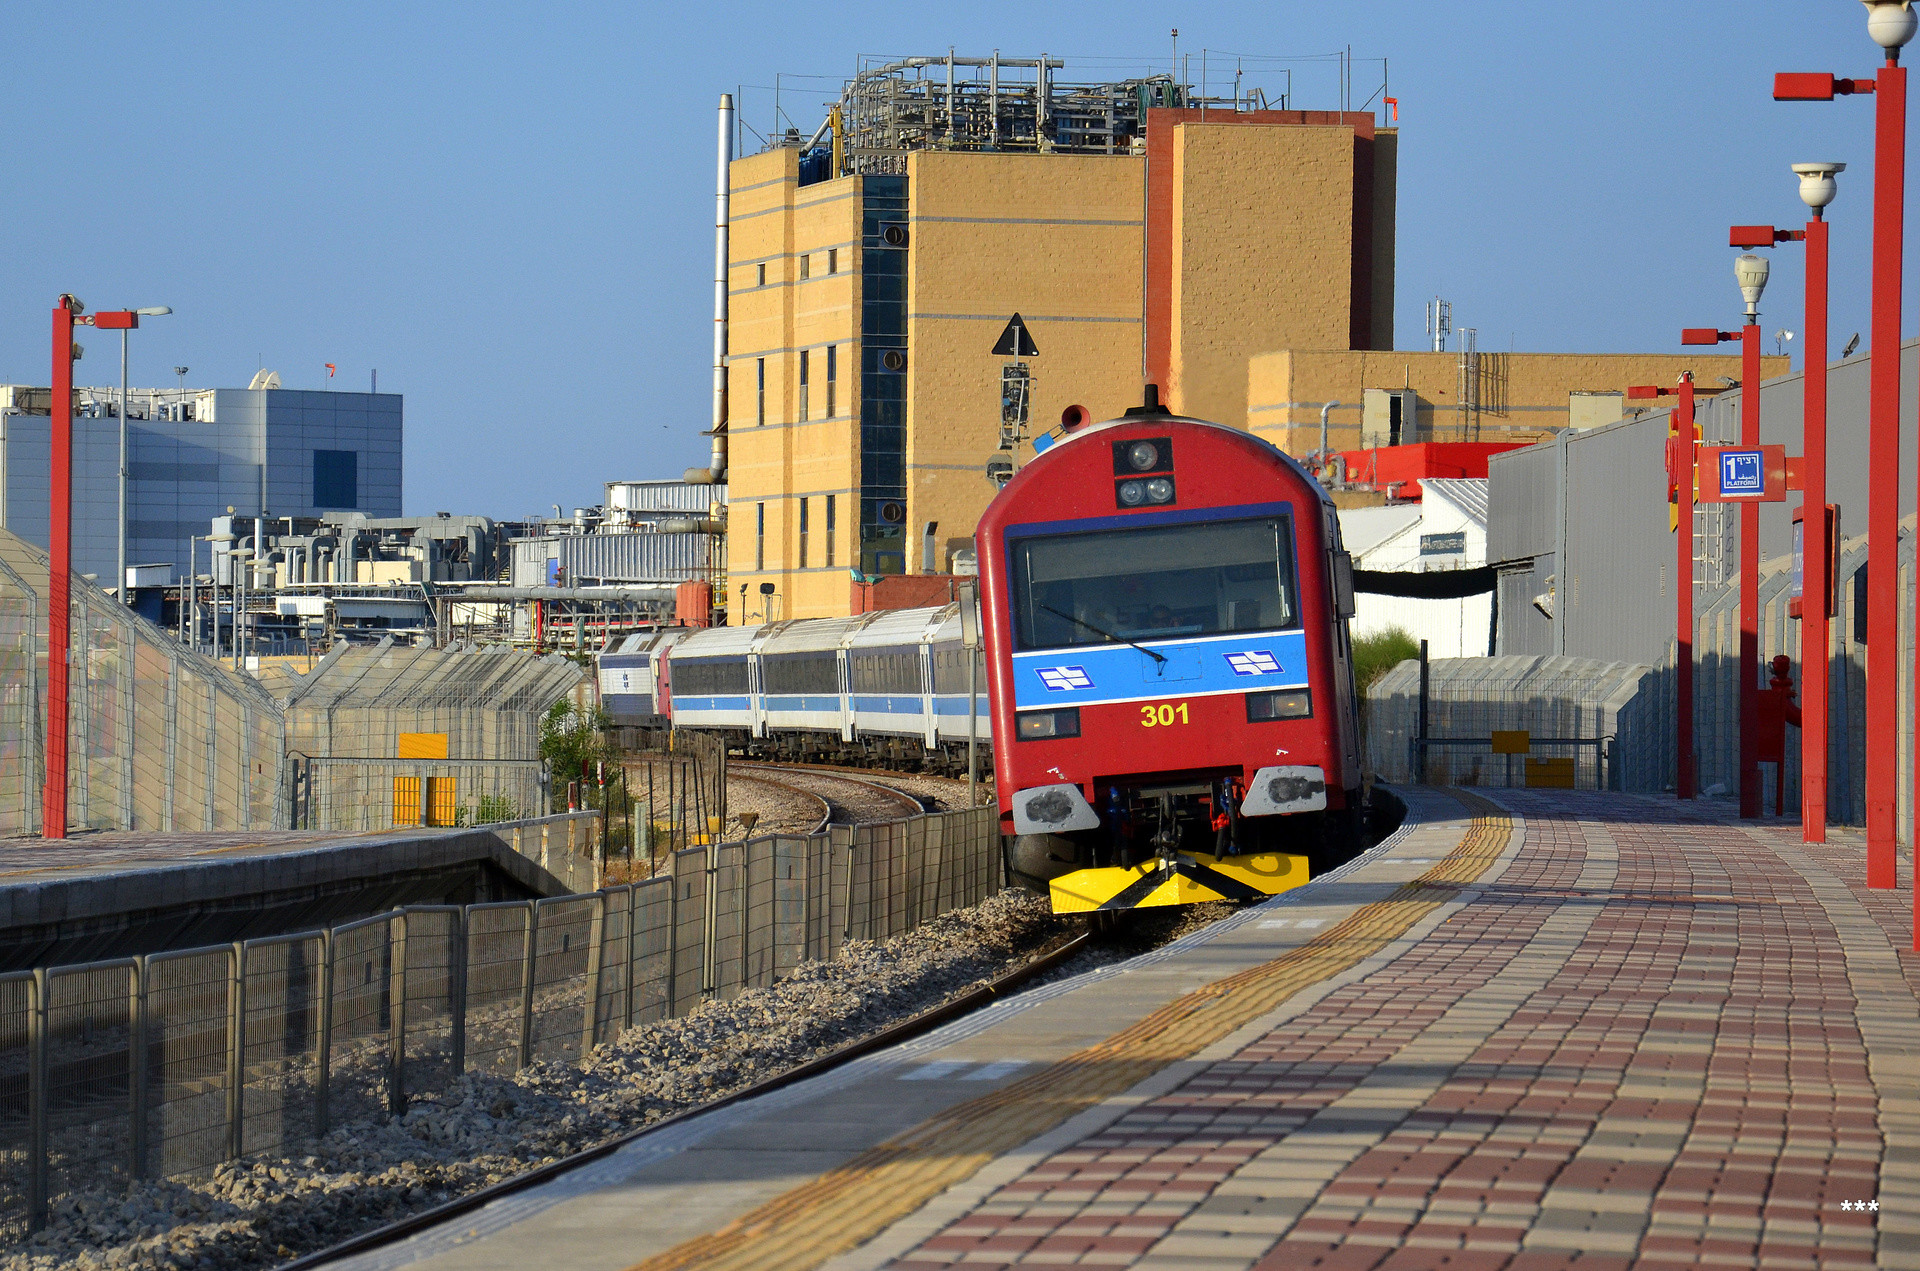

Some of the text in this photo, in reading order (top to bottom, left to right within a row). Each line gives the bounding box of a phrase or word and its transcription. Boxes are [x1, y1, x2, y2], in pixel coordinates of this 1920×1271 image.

[1727, 458, 1736, 480] 1
[1737, 457, 1756, 465] רציף
[1141, 703, 1188, 727] 301
